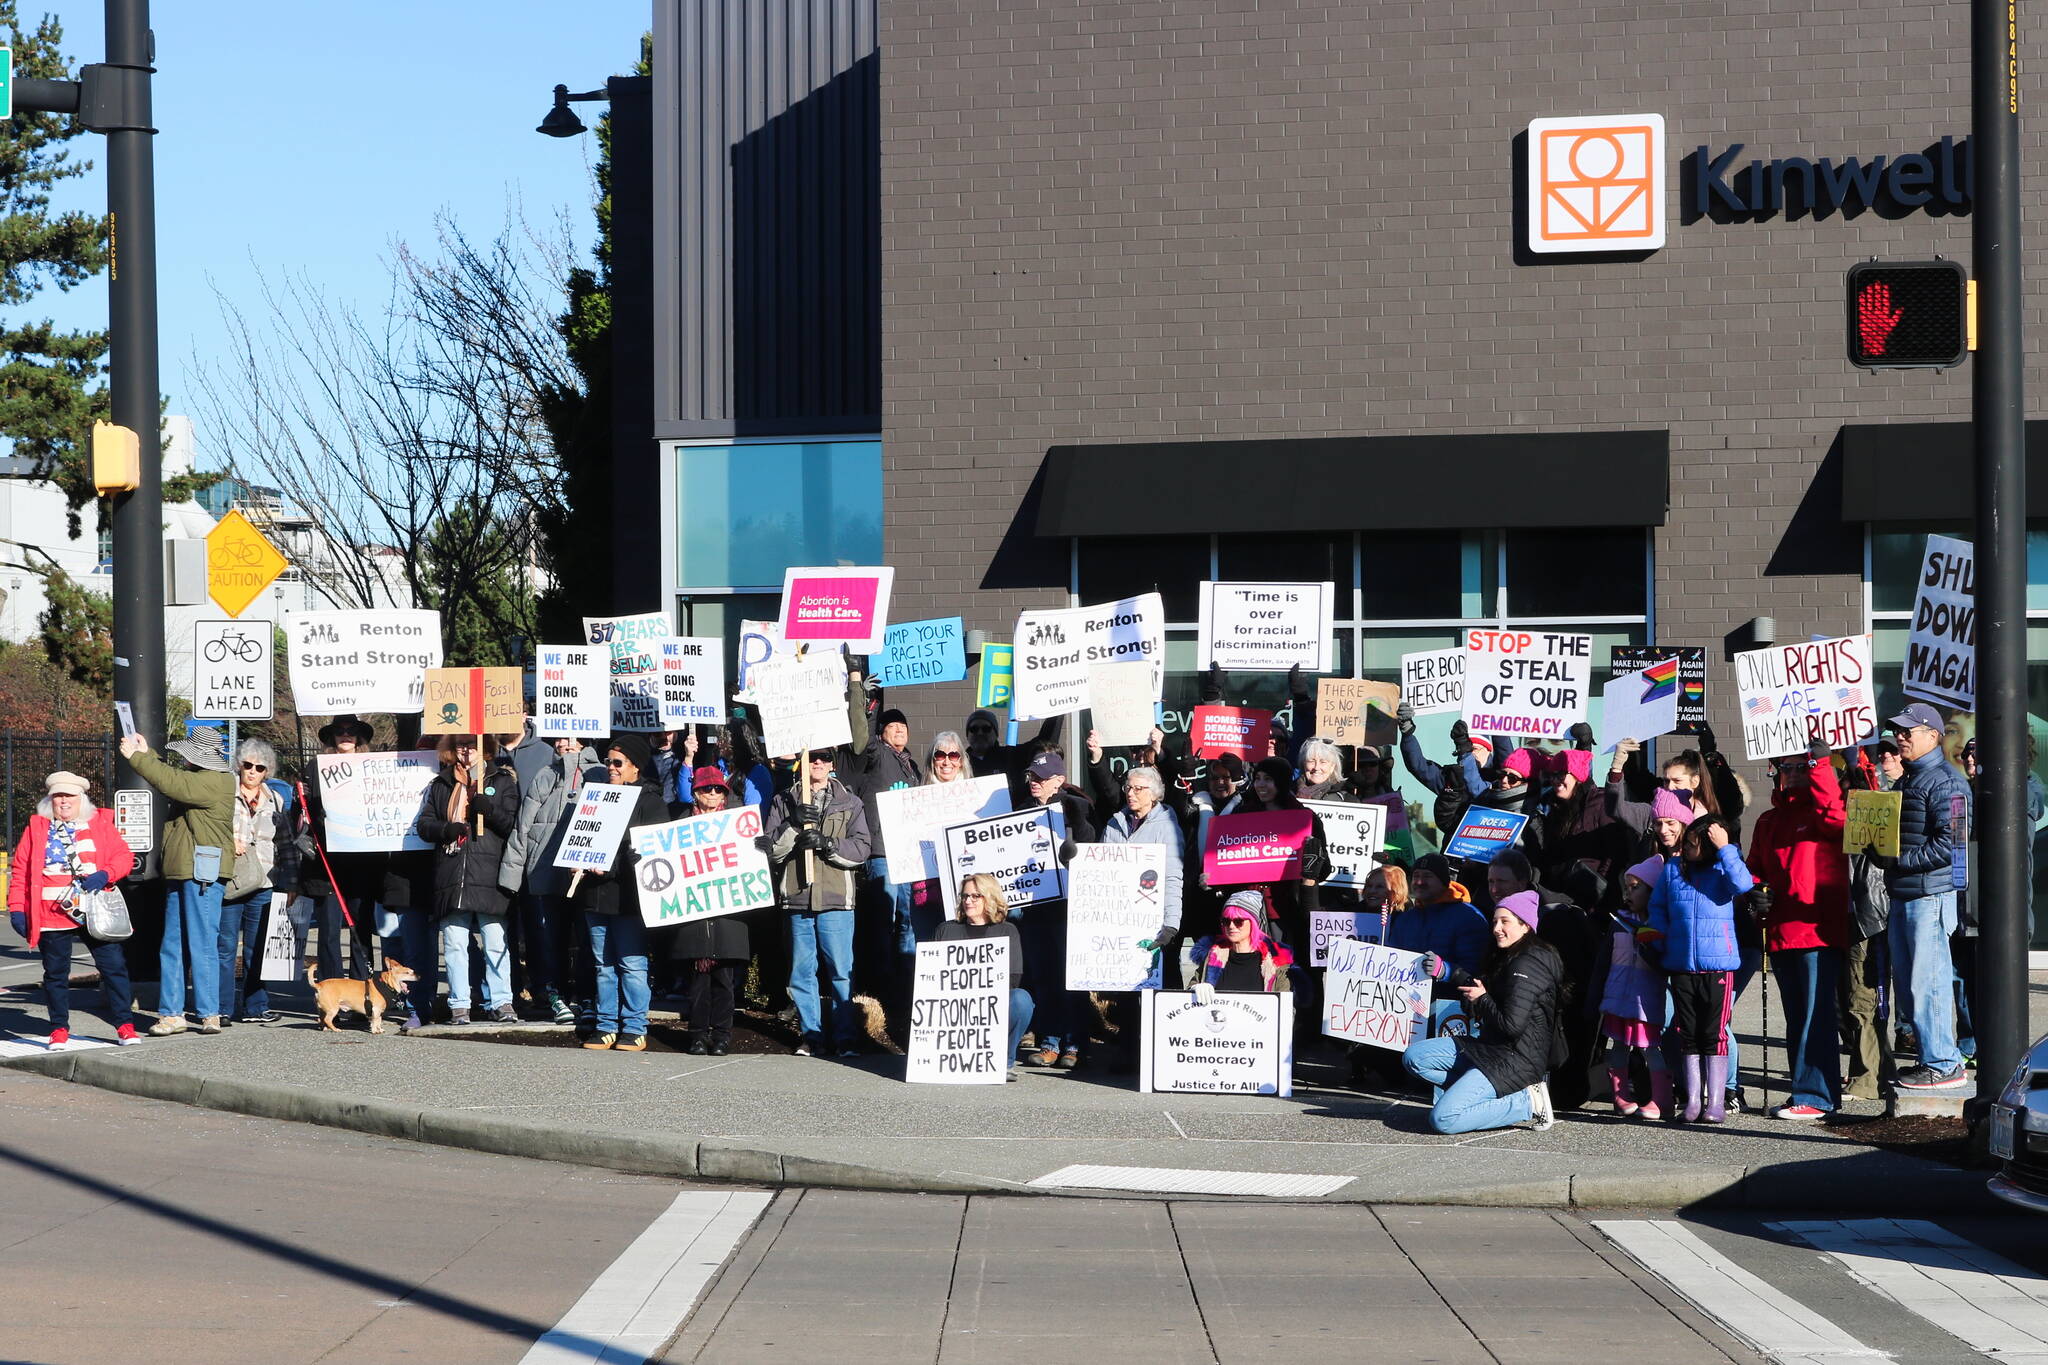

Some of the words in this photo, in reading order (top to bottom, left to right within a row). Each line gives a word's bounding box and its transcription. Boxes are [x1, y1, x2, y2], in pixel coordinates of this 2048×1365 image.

[2008, 0, 2016, 114] 884C95
[208, 572, 263, 586] AUTION
[800, 595, 840, 606] Abortion
[842, 596, 849, 605] is
[1235, 591, 1280, 602] "Time
[1286, 591, 1298, 602] is
[798, 608, 832, 618] Health
[834, 608, 862, 618] Care.
[1250, 610, 1284, 620] over
[360, 624, 422, 636] Renton
[1084, 612, 1143, 634] Renton
[1234, 625, 1252, 635] for
[1258, 626, 1296, 635] racial
[590, 622, 616, 644] 57
[616, 617, 669, 641] YEARS
[884, 628, 908, 646] UMP
[916, 624, 955, 642] YOUR
[663, 644, 678, 655] WE
[684, 645, 702, 656] ARE
[892, 641, 948, 662] RACIST
[1214, 640, 1317, 650] discrimination!"
[1468, 632, 1532, 653] STOP
[1543, 634, 1590, 658] THE
[301, 652, 358, 668] Stand
[366, 650, 434, 668] Strong!
[544, 653, 561, 665] WE
[567, 654, 588, 666] ARE
[1026, 650, 1080, 670] Stand
[1086, 636, 1158, 661] Strong!
[610, 654, 657, 674] SELM
[884, 660, 944, 682] FRIEND
[1407, 658, 1435, 682] HER
[1439, 655, 1466, 677] BOD
[1500, 660, 1576, 682] STEAL
[1736, 650, 1784, 692] CIVIL
[1784, 639, 1862, 686] RIGHTS
[210, 676, 255, 690] LANE
[311, 678, 376, 690] Community
[664, 675, 695, 686] GOING
[1036, 676, 1088, 692] Communi
[430, 681, 466, 701] BAN
[544, 686, 578, 698] GOING
[665, 691, 695, 702] BACK.
[1324, 683, 1364, 698] THERE
[1407, 683, 1436, 706] HER
[1481, 684, 1514, 704] OF
[1530, 688, 1577, 710] OUR
[204, 696, 262, 710] AHEAD
[326, 696, 357, 706] Unity
[622, 698, 653, 711] STILL
[1048, 694, 1080, 708] Unity
[1325, 701, 1336, 711] IS
[1339, 700, 1354, 711] NO
[1777, 688, 1820, 717] ARE
[485, 703, 522, 718] FUELS
[544, 703, 577, 715] BACK.
[666, 705, 687, 716] LIKE
[690, 706, 718, 718] EVER.
[544, 719, 567, 730] LIKE
[572, 719, 602, 731] EVER.
[1205, 716, 1236, 724] MOMS
[1472, 714, 1562, 734] DEMOCRACY
[1204, 724, 1249, 734] DEMAND
[1746, 716, 1806, 756] HUMAN
[1806, 706, 1874, 746] RIGHTS
[1204, 733, 1242, 742] ACTION
[321, 762, 352, 788] PRO
[362, 759, 419, 776] FREEDOM
[362, 776, 406, 791] FAMILY
[586, 789, 601, 801] WE
[603, 791, 621, 803] ARE
[574, 820, 602, 832] GOING
[1480, 817, 1498, 826] ROE
[1498, 819, 1508, 827] IS
[640, 814, 731, 856] EVERY
[964, 820, 1037, 844] Believe
[1217, 833, 1266, 846] Abortion
[1269, 832, 1278, 842] is
[1468, 828, 1492, 838] HUMAN
[1850, 826, 1886, 847] LOVE
[568, 836, 593, 848] BACK.
[562, 850, 582, 862] LIKE
[583, 852, 606, 864] EVER.
[1084, 846, 1143, 864] ASPHALT
[1217, 846, 1263, 860] Health
[1265, 845, 1297, 856] Care.
[680, 843, 738, 878] LIFE
[1075, 870, 1123, 882] ARSENIC
[1000, 877, 1041, 892] ustice
[1076, 884, 1128, 898] BENZENE
[660, 869, 771, 919] MATTERS
[1007, 892, 1029, 903] ALL!
[1316, 919, 1353, 931] BANS
[1092, 936, 1131, 952] SAVE
[947, 944, 994, 966] POWER
[995, 947, 1005, 955] OF
[1071, 952, 1089, 966] THE
[1330, 940, 1356, 972] We
[1360, 946, 1386, 978] The
[940, 967, 994, 990] PEOPLE
[1086, 968, 1128, 979] RIVER
[1344, 978, 1407, 1014] MEANS
[912, 995, 999, 1027] STRONGER
[1166, 1009, 1181, 1020] We
[1233, 1000, 1240, 1008] it
[1243, 1004, 1267, 1023] Ring!
[1331, 1004, 1423, 1046] EVERYONE
[937, 1029, 991, 1050] PEOPLE
[1169, 1037, 1189, 1047] We
[1194, 1037, 1246, 1048] Believe
[1251, 1039, 1263, 1049] in
[939, 1052, 996, 1073] POWER
[1176, 1053, 1256, 1067] Democracy
[1172, 1080, 1216, 1090] Justice
[1220, 1081, 1235, 1090] for
[1240, 1081, 1260, 1091] All!
